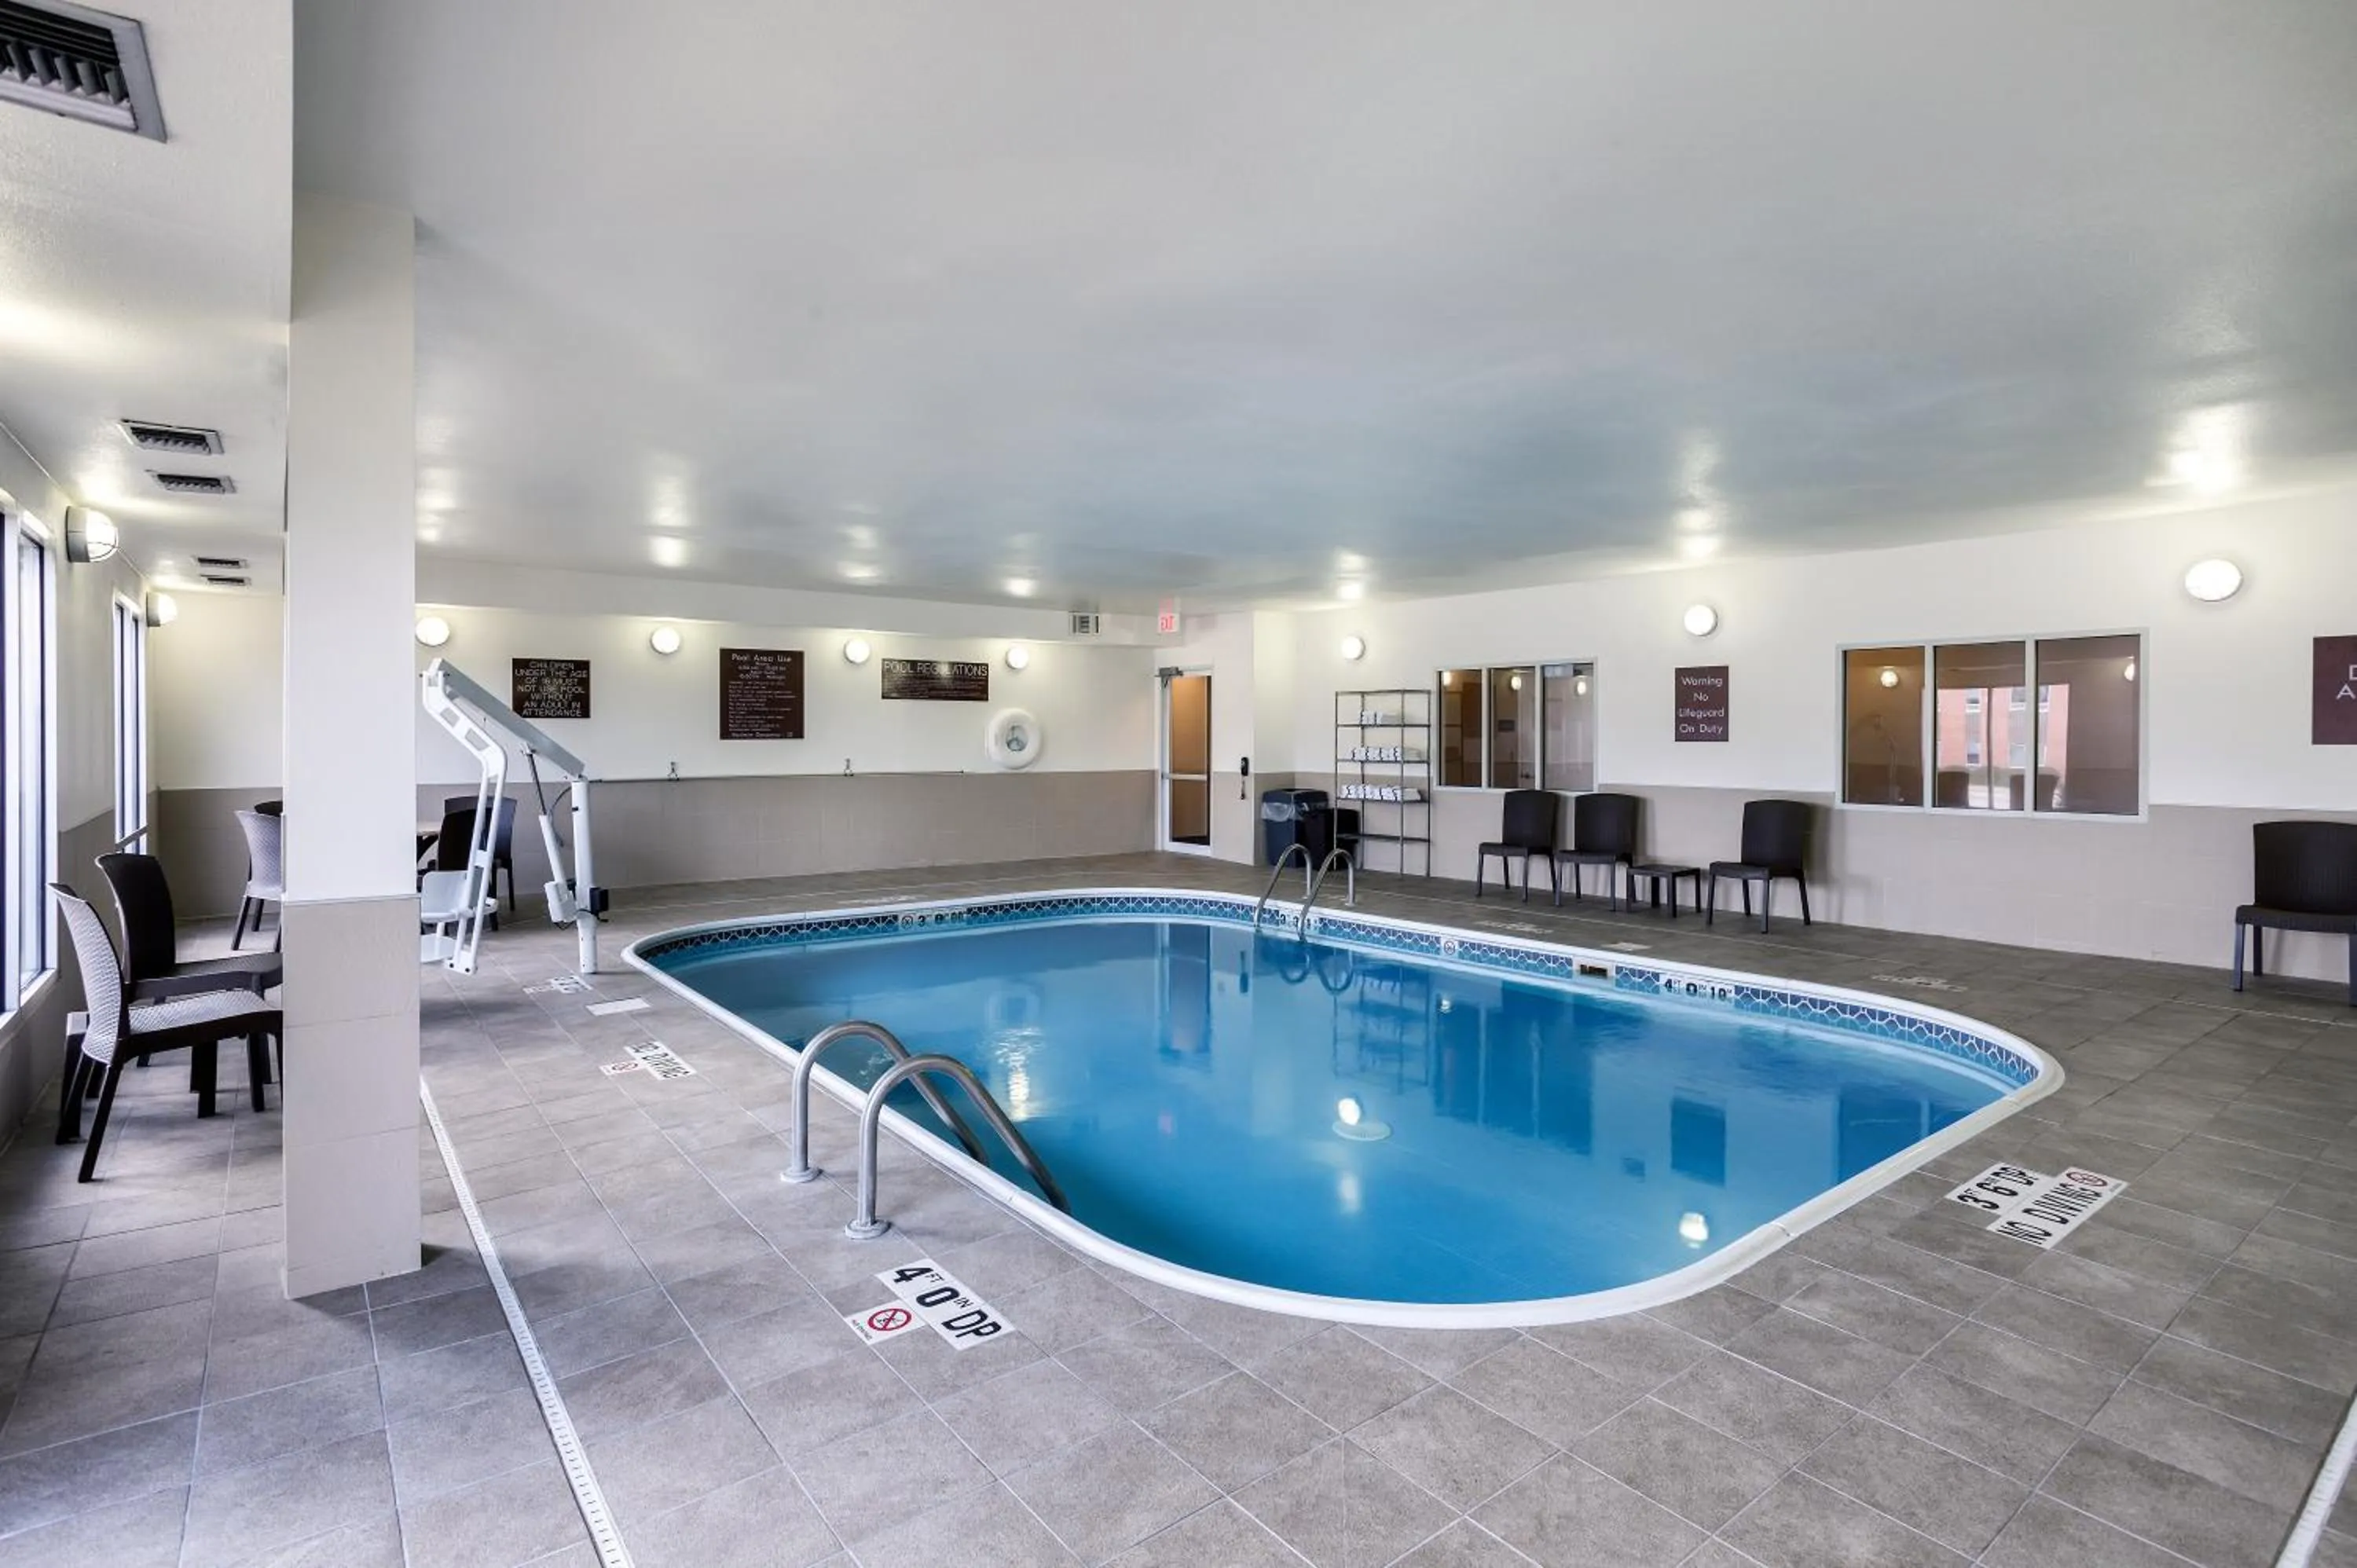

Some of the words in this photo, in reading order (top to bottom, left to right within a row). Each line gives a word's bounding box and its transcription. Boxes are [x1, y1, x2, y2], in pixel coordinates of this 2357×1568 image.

[529, 661, 574, 670] CHILDREN
[884, 661, 914, 673] POOL
[917, 662, 988, 676] REGLATIONS
[1681, 676, 1723, 687] Warning
[530, 692, 574, 701] WITHOUT
[1693, 692, 1709, 702] No
[522, 709, 582, 717] ATTENDANCE
[1679, 707, 1725, 719] Lifeguard
[1680, 724, 1695, 733] On
[1699, 724, 1723, 734] Duty
[1976, 1182, 2018, 1196] 6
[2022, 1182, 2103, 1225] DIVING
[1996, 1220, 2053, 1246] NO
[893, 1267, 934, 1284] 4
[916, 1287, 960, 1308] 0
[941, 1309, 1003, 1339] DP
